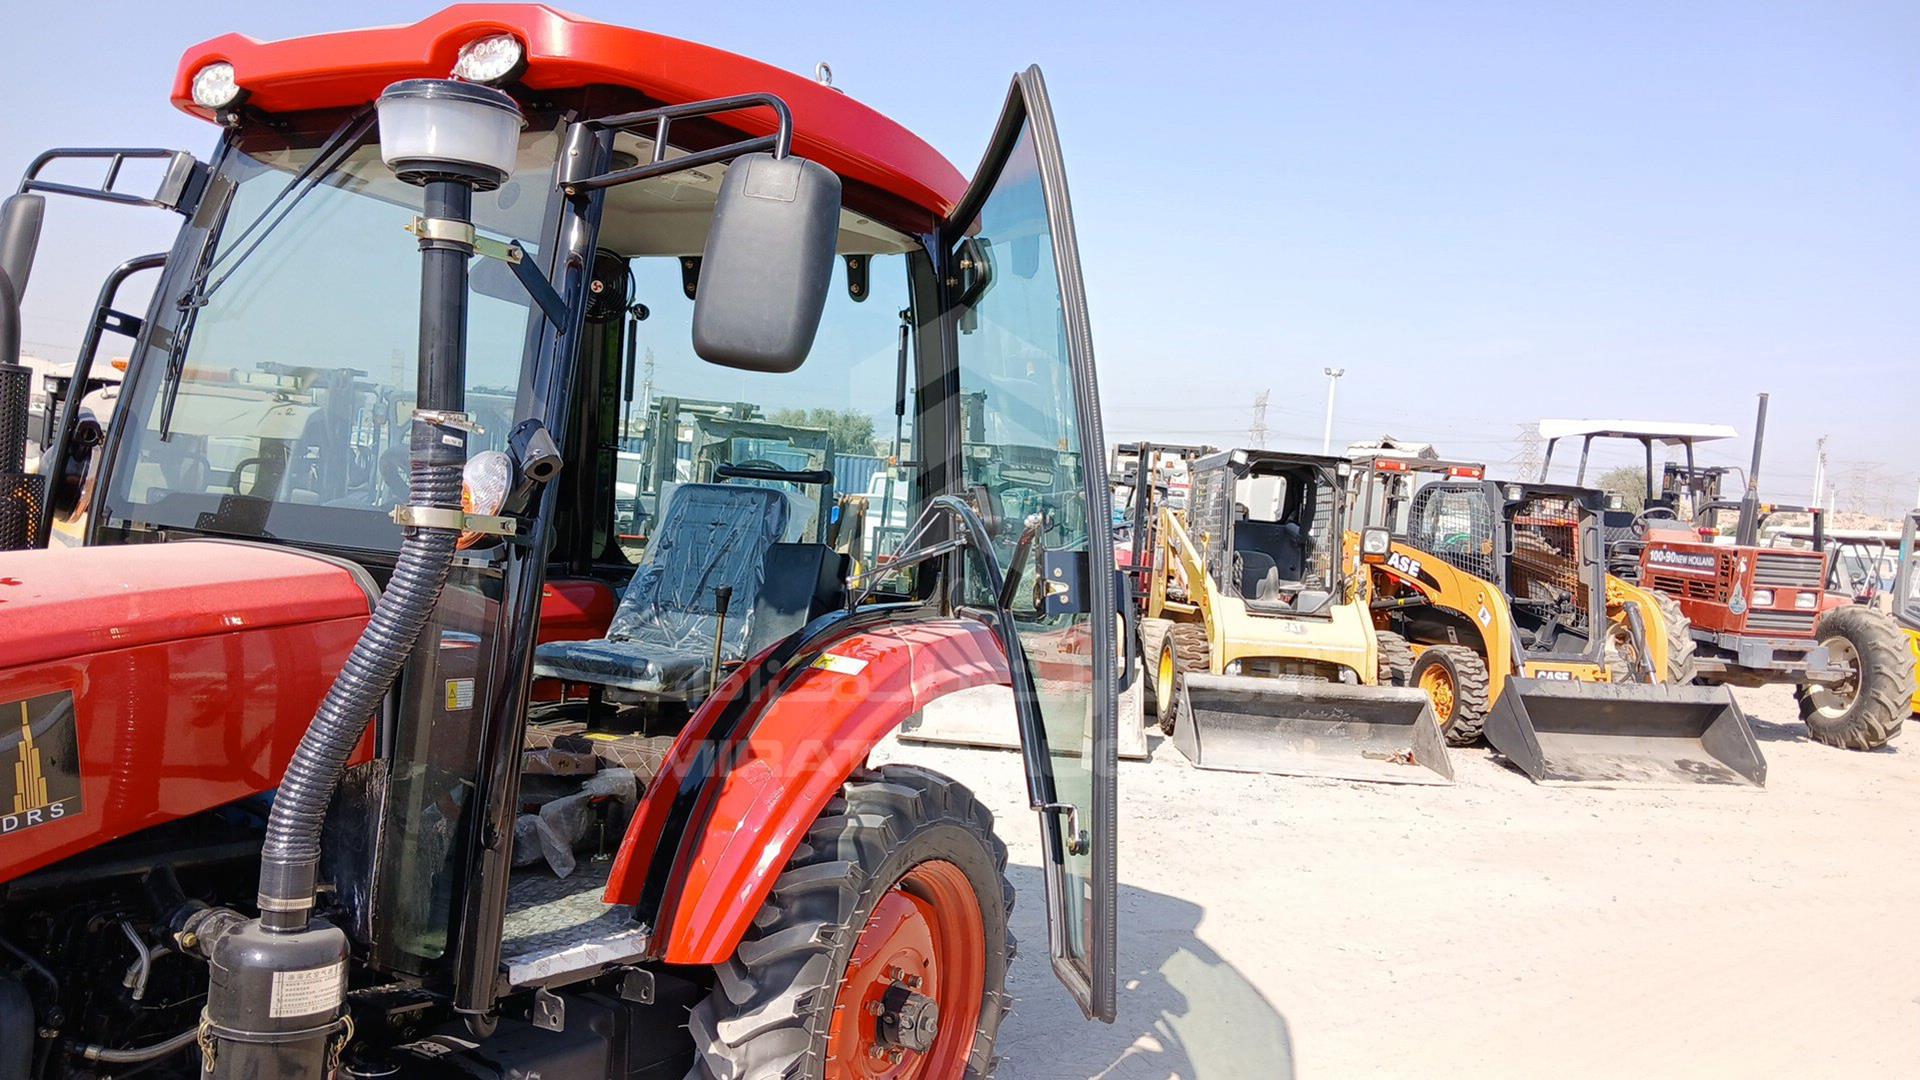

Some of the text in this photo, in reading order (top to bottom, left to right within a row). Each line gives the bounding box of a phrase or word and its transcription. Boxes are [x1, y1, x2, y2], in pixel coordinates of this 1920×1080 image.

[1386, 552, 1421, 578] ASE
[1649, 549, 1676, 563] 100-90
[1688, 555, 1715, 567] HOLLAND
[1537, 670, 1570, 681] CASE
